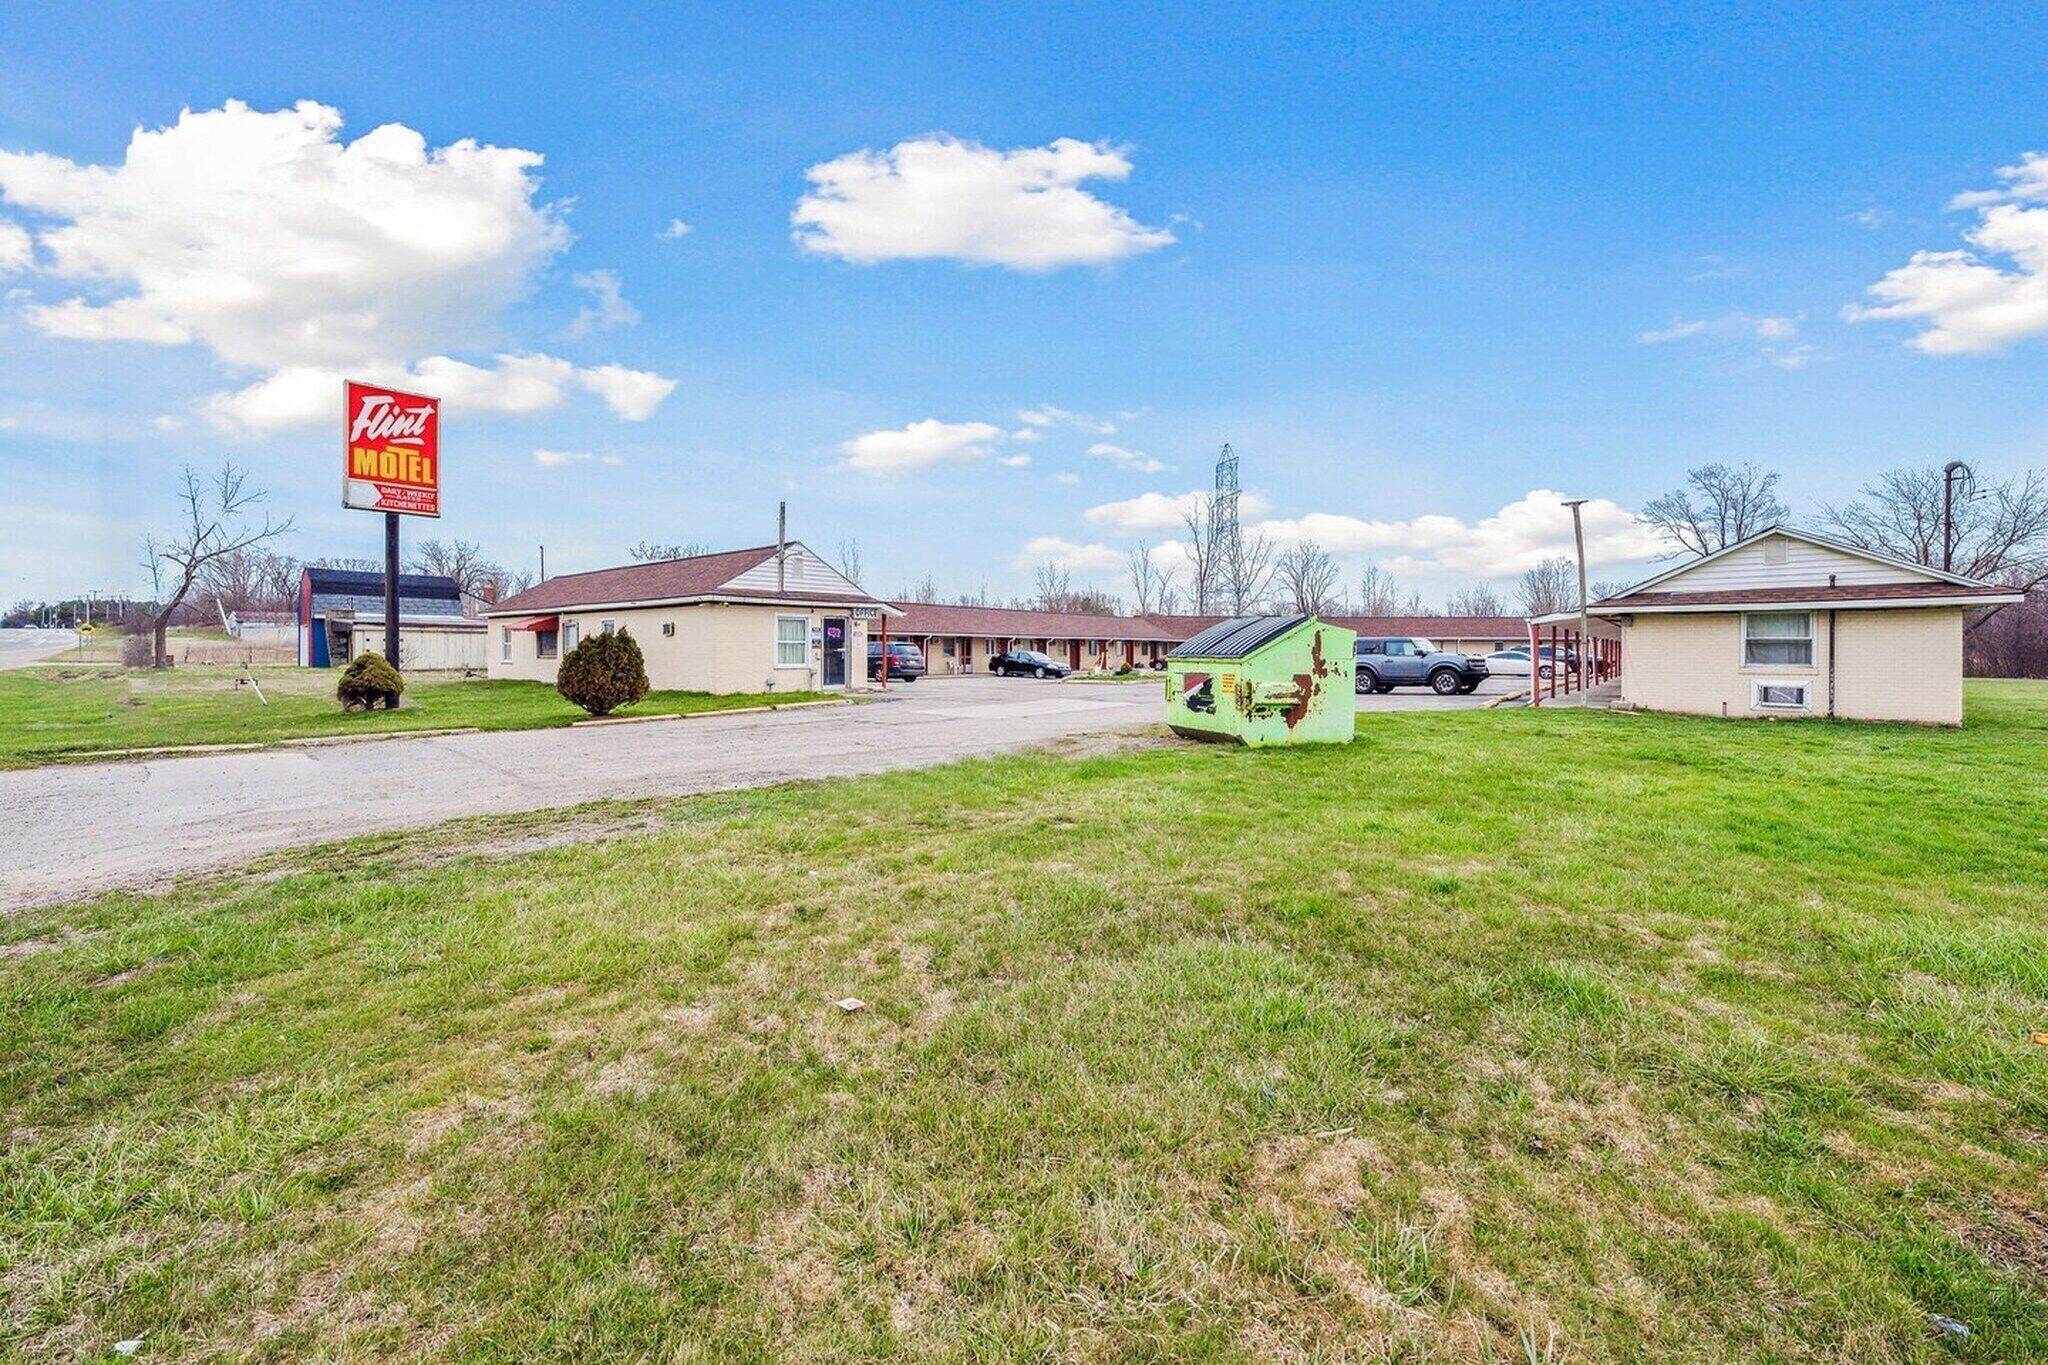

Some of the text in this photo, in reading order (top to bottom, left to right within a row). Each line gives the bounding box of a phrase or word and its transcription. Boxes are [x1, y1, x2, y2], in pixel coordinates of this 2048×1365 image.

[350, 395, 436, 445] Flint
[353, 445, 435, 485] MOTEL
[381, 498, 435, 511] KITCHENETTES
[854, 607, 877, 617] OFFICE
